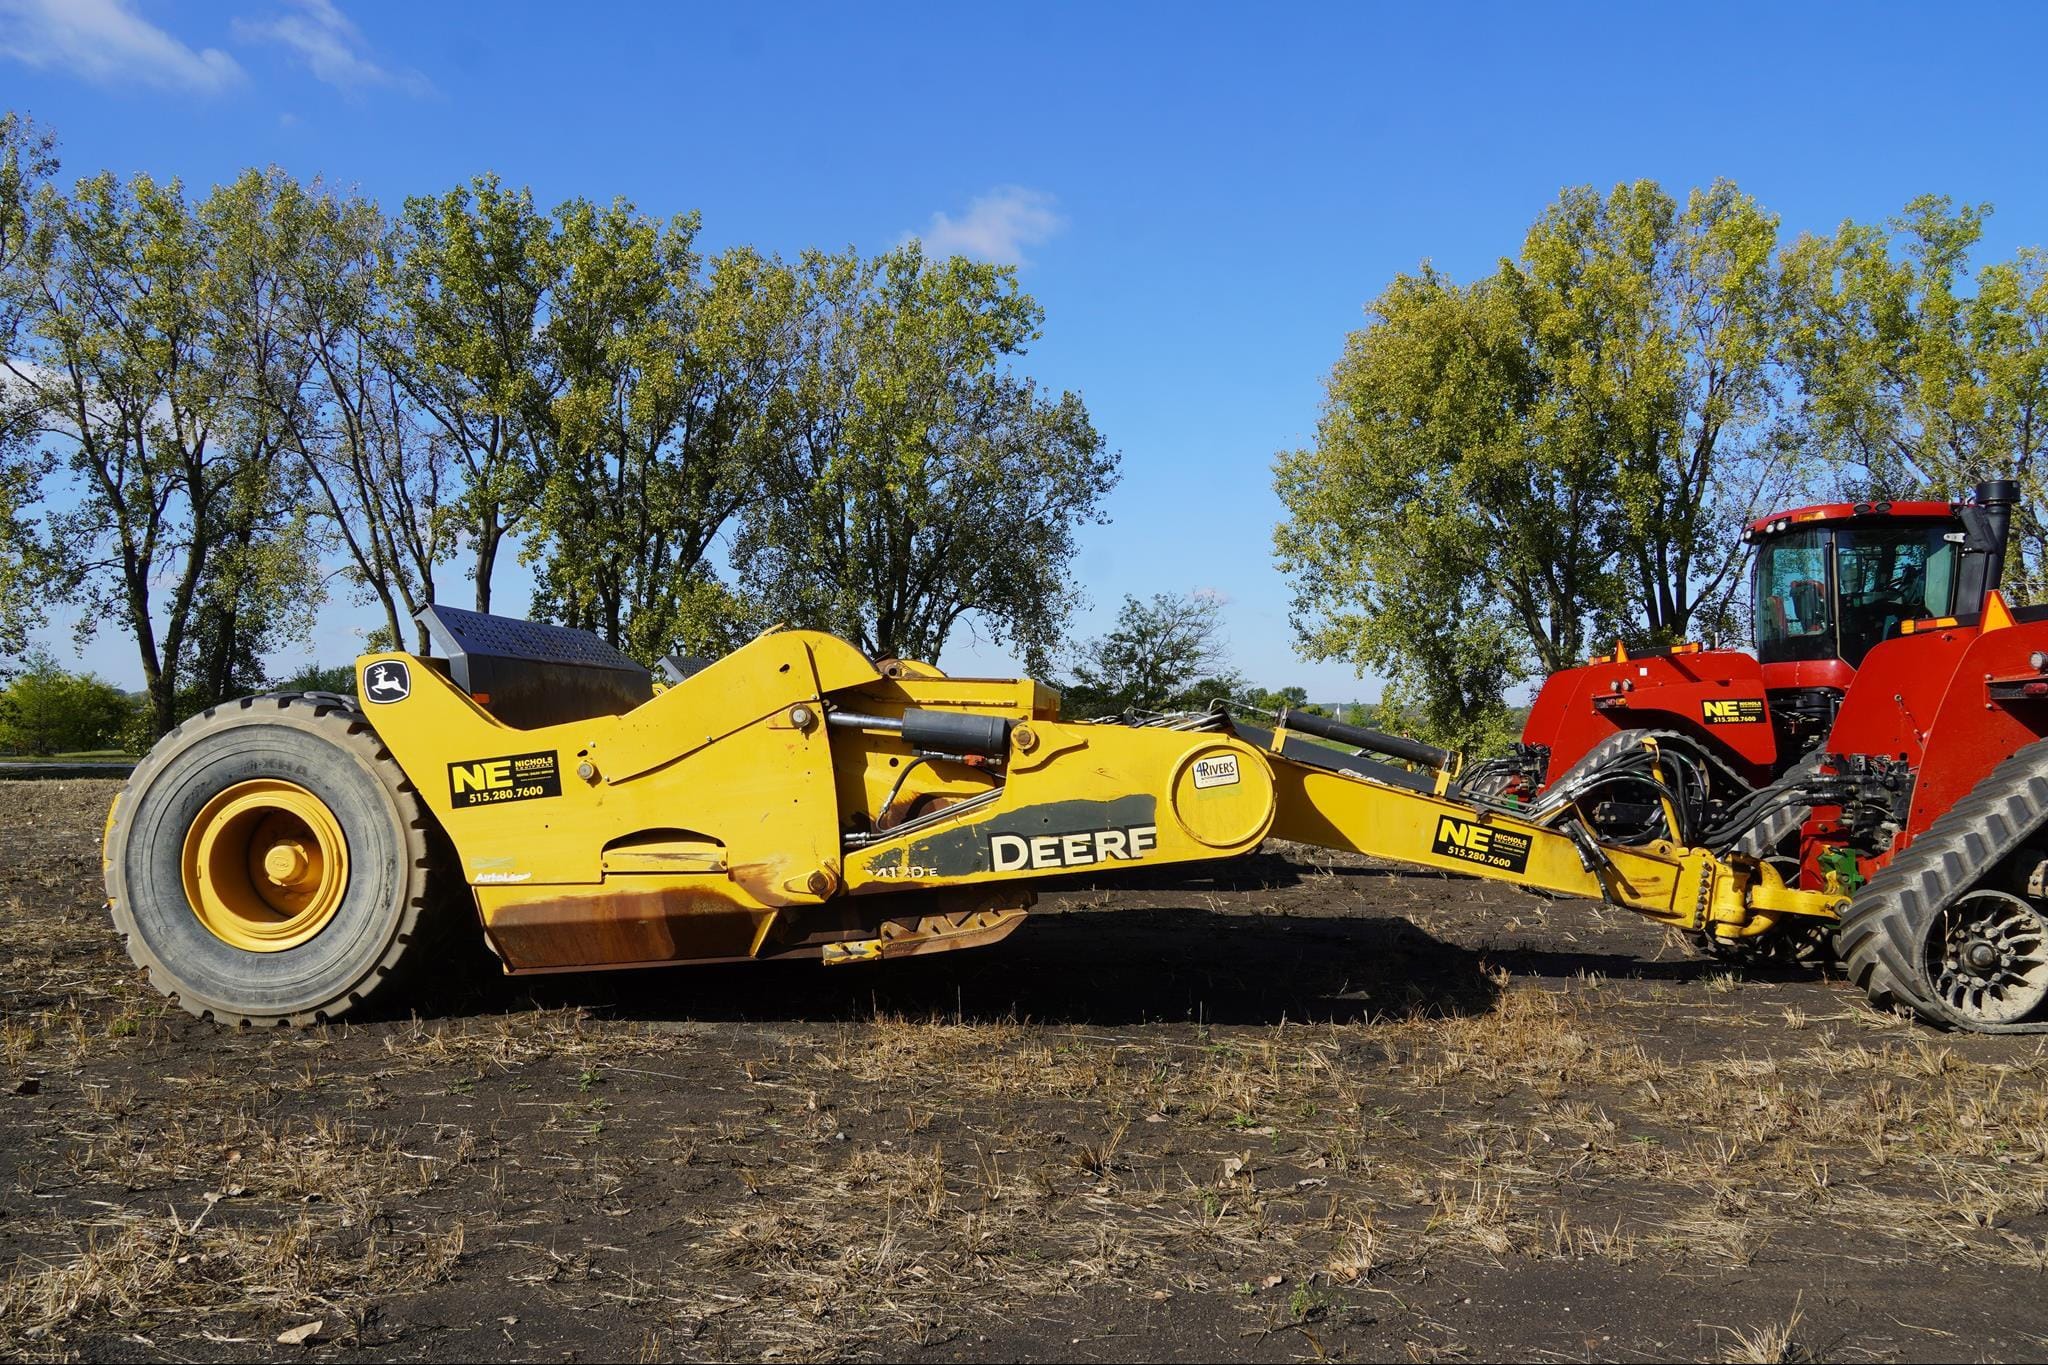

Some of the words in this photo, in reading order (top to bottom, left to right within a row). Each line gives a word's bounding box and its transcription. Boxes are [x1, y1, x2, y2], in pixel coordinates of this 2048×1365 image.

[1703, 701, 1740, 717] NE
[515, 757, 554, 768] NICHOLS
[1196, 761, 1235, 777] 4RIVERS
[452, 760, 514, 794] NE
[469, 785, 544, 803] 515.280.7600
[1438, 818, 1493, 852] NE
[1494, 833, 1528, 846] NICHOLS
[1447, 846, 1511, 868] 515.280.7600
